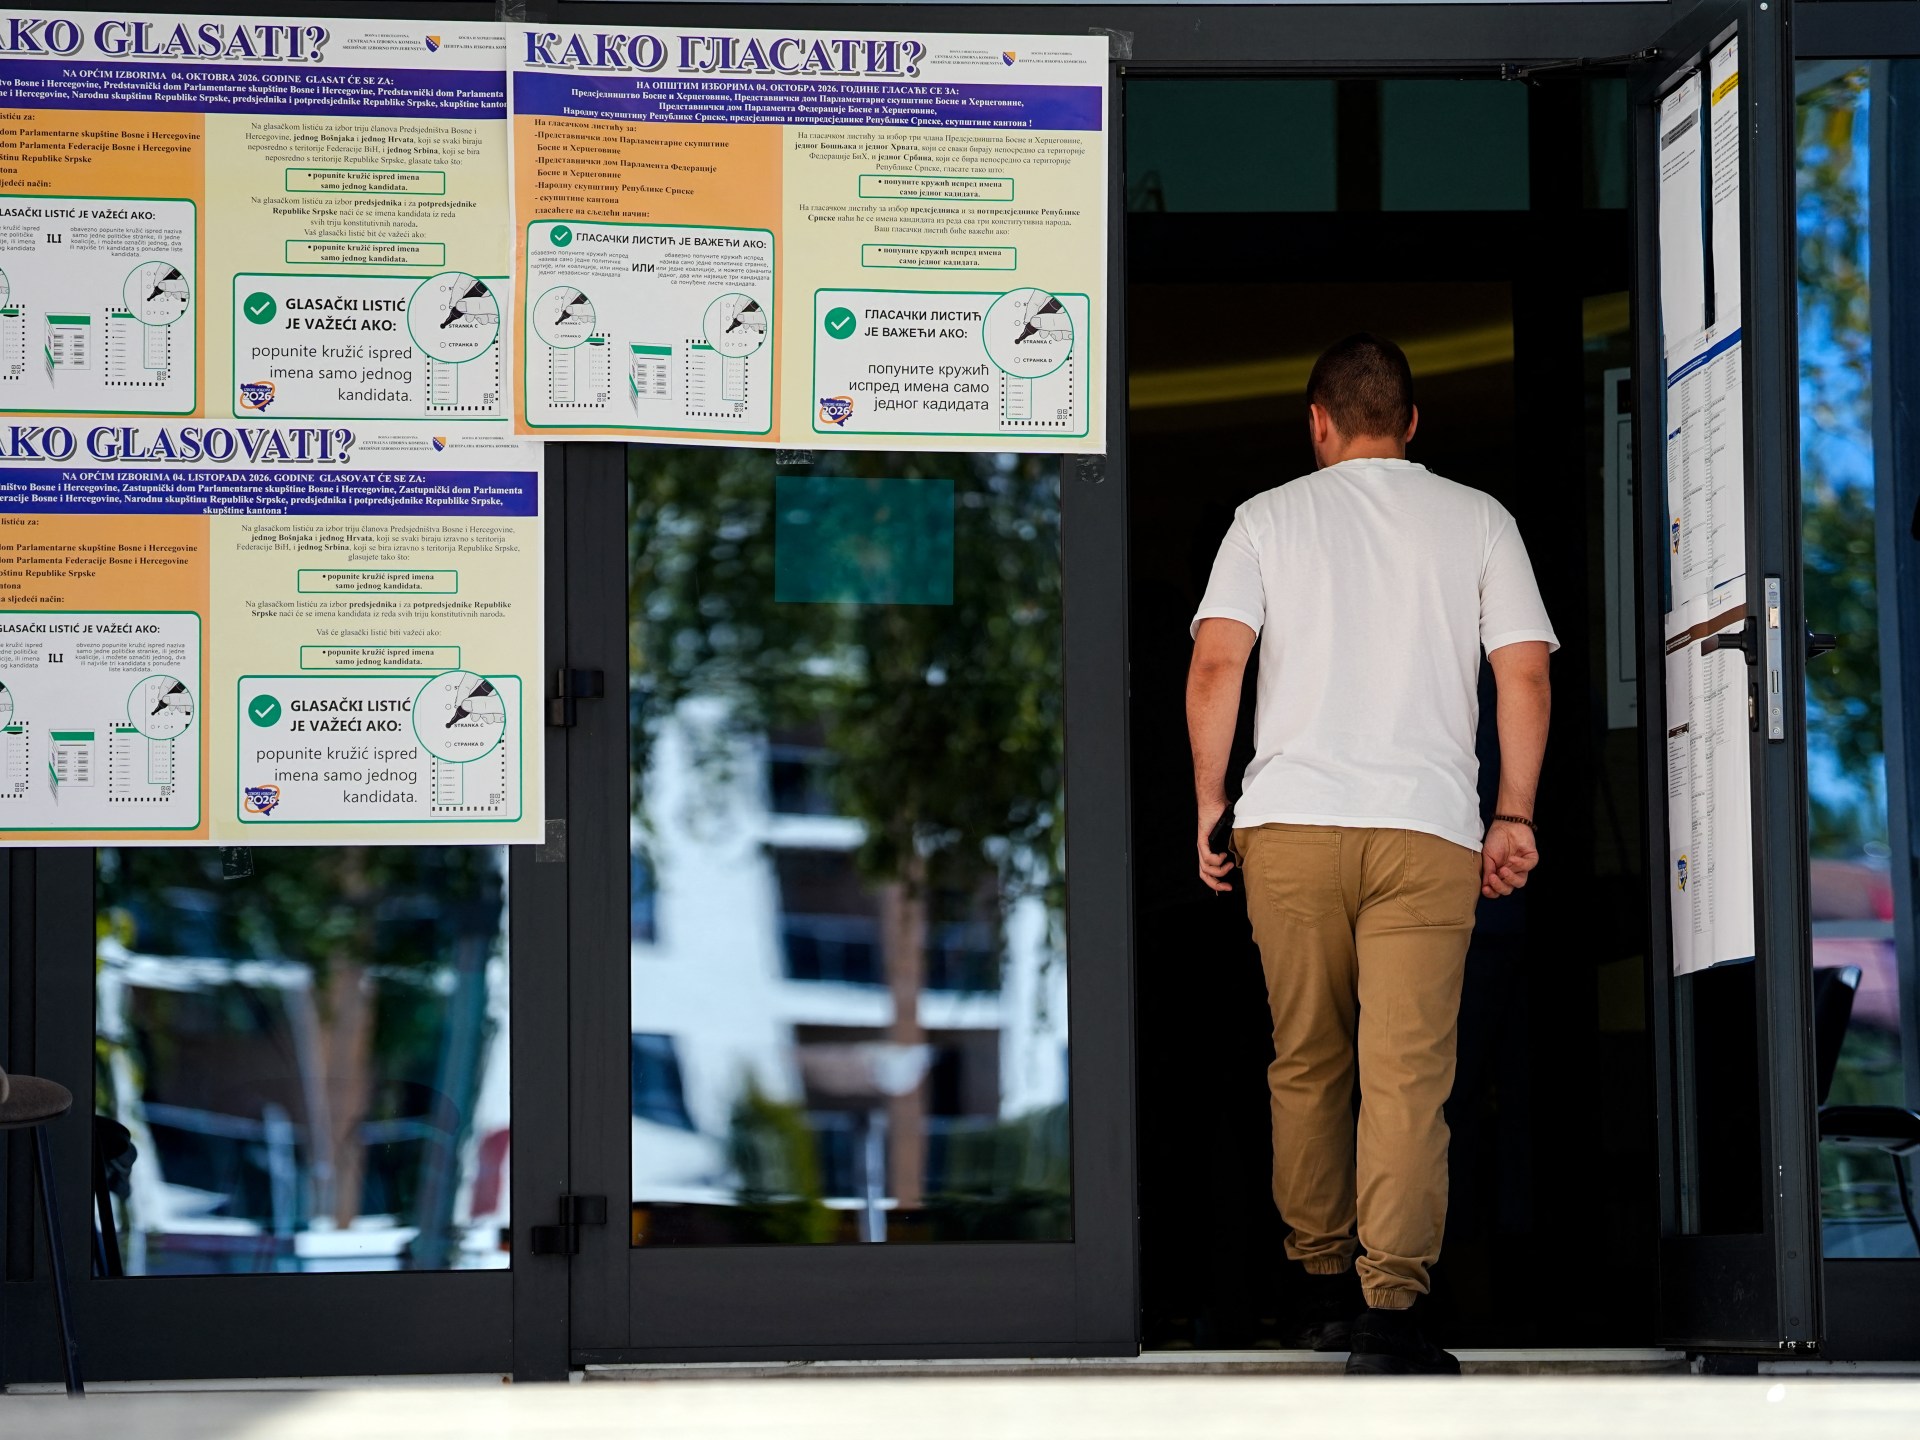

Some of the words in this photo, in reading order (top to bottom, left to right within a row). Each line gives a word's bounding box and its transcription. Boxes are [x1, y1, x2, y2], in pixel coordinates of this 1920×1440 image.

[0, 18, 84, 56] KO
[94, 20, 330, 62] GLASATI?
[523, 31, 668, 72] КАКО
[677, 36, 926, 78] ГЛАСАТИ?
[63, 69, 76, 77] NA
[79, 68, 112, 78] OPĆIM
[115, 70, 166, 79] IZBORIMA
[185, 72, 235, 81] OKTOBRA
[238, 73, 259, 81] 2026.
[261, 74, 301, 82] GODINE
[305, 75, 345, 83] GLASAT
[347, 74, 361, 84] ĆE
[363, 76, 375, 84] SE
[652, 81, 698, 89] ОПШТИМ
[701, 82, 754, 90] ИЗБОРИМА
[770, 83, 815, 91] ОКТОБРА
[817, 84, 838, 92] 2026.
[840, 85, 879, 93] ГОДИНЕ
[882, 86, 927, 94] ГЛАСАЋЕ
[659, 102, 724, 111] Представнички
[744, 103, 795, 113] Парламента
[797, 104, 845, 114] Федерације
[848, 105, 872, 113] Босне
[881, 106, 937, 115] Херцеговине,
[19, 128, 79, 137] Parlamentarne
[81, 130, 118, 139] skupštine
[152, 131, 200, 140] Hercegovine
[591, 124, 622, 132] листићу
[313, 172, 345, 180] popunite
[372, 173, 395, 181] ispred
[921, 179, 949, 187] кружић
[574, 184, 619, 192] скупштину
[622, 184, 663, 193] Републике
[665, 186, 694, 195] Српске
[919, 189, 940, 197] једног
[0, 207, 41, 217] LASAČKI
[45, 207, 75, 218] LISTIĆ
[78, 210, 88, 218] JE
[91, 208, 127, 219] VAŽEĆI
[130, 211, 155, 219] AKO:
[46, 233, 61, 243] ILI
[576, 232, 628, 243] ГЛАСАЧКИ
[632, 235, 675, 245] ЛИСТИЋ
[678, 237, 690, 245] ЈЕ
[694, 237, 739, 247] ВАЖЕЋИ
[742, 239, 766, 248] АКО:
[632, 263, 654, 272] ИЛИ
[285, 296, 357, 310] GLASAČKI
[362, 297, 405, 311] LISTIĆ
[865, 309, 926, 320] ГЛАСАЧКИ
[930, 311, 981, 320] ЛИСТИЋ
[285, 318, 299, 329] JE
[304, 316, 356, 330] VAŽEĆI
[360, 319, 396, 331] AKO:
[864, 326, 878, 336] ЈЕ
[882, 327, 935, 337] ВАЖЕЋИ
[939, 328, 967, 338] АКО:
[252, 344, 316, 360] popunite
[322, 344, 363, 358] kružić
[368, 345, 411, 361] ispred
[270, 365, 313, 378] imena
[318, 369, 357, 379] samo
[360, 367, 411, 383] jednog
[868, 364, 933, 377] попуните
[939, 363, 988, 378] кружић
[849, 381, 899, 394] испред
[904, 382, 948, 392] имена
[953, 383, 989, 392] само
[244, 391, 271, 401] 2026
[338, 387, 411, 401] kandidata.
[873, 396, 918, 411] једног
[923, 400, 988, 411] кадидата
[823, 406, 850, 416] 2026
[0, 426, 77, 461] KO
[87, 426, 356, 463] GLASOVATI?
[62, 472, 77, 480] NA
[79, 471, 114, 480] OPĆIM
[117, 472, 170, 480] IZBORIMA
[172, 473, 185, 481] 04.
[188, 473, 246, 481] LISTOPADA
[249, 473, 271, 481] 2026.
[273, 473, 314, 481] GODINE
[319, 474, 375, 482] GLASOVAT
[377, 474, 391, 482] ĆE
[203, 506, 244, 514] skupštine
[246, 506, 281, 514] kantona
[65, 556, 106, 565] Federacije
[139, 557, 188, 565] Hercegovine
[49, 622, 79, 632] LISTIĆ
[82, 624, 92, 633] JE
[95, 622, 132, 633] VAŽEĆI
[135, 624, 159, 633] AKO:
[340, 628, 368, 637] glasački
[48, 653, 63, 662] ILI
[290, 697, 362, 711] GLASAČKI
[368, 697, 410, 711] LISTIĆ
[290, 720, 304, 731] JE
[309, 717, 361, 731] VAŽEĆI
[366, 720, 401, 731] AKO:
[256, 746, 321, 763] popunite
[327, 746, 368, 759] kružić
[374, 746, 416, 762] ispred
[274, 768, 318, 781] imena
[323, 771, 362, 781] samo
[365, 768, 416, 784] jednog
[248, 795, 276, 805] 2026
[343, 789, 416, 802] kandidata.
